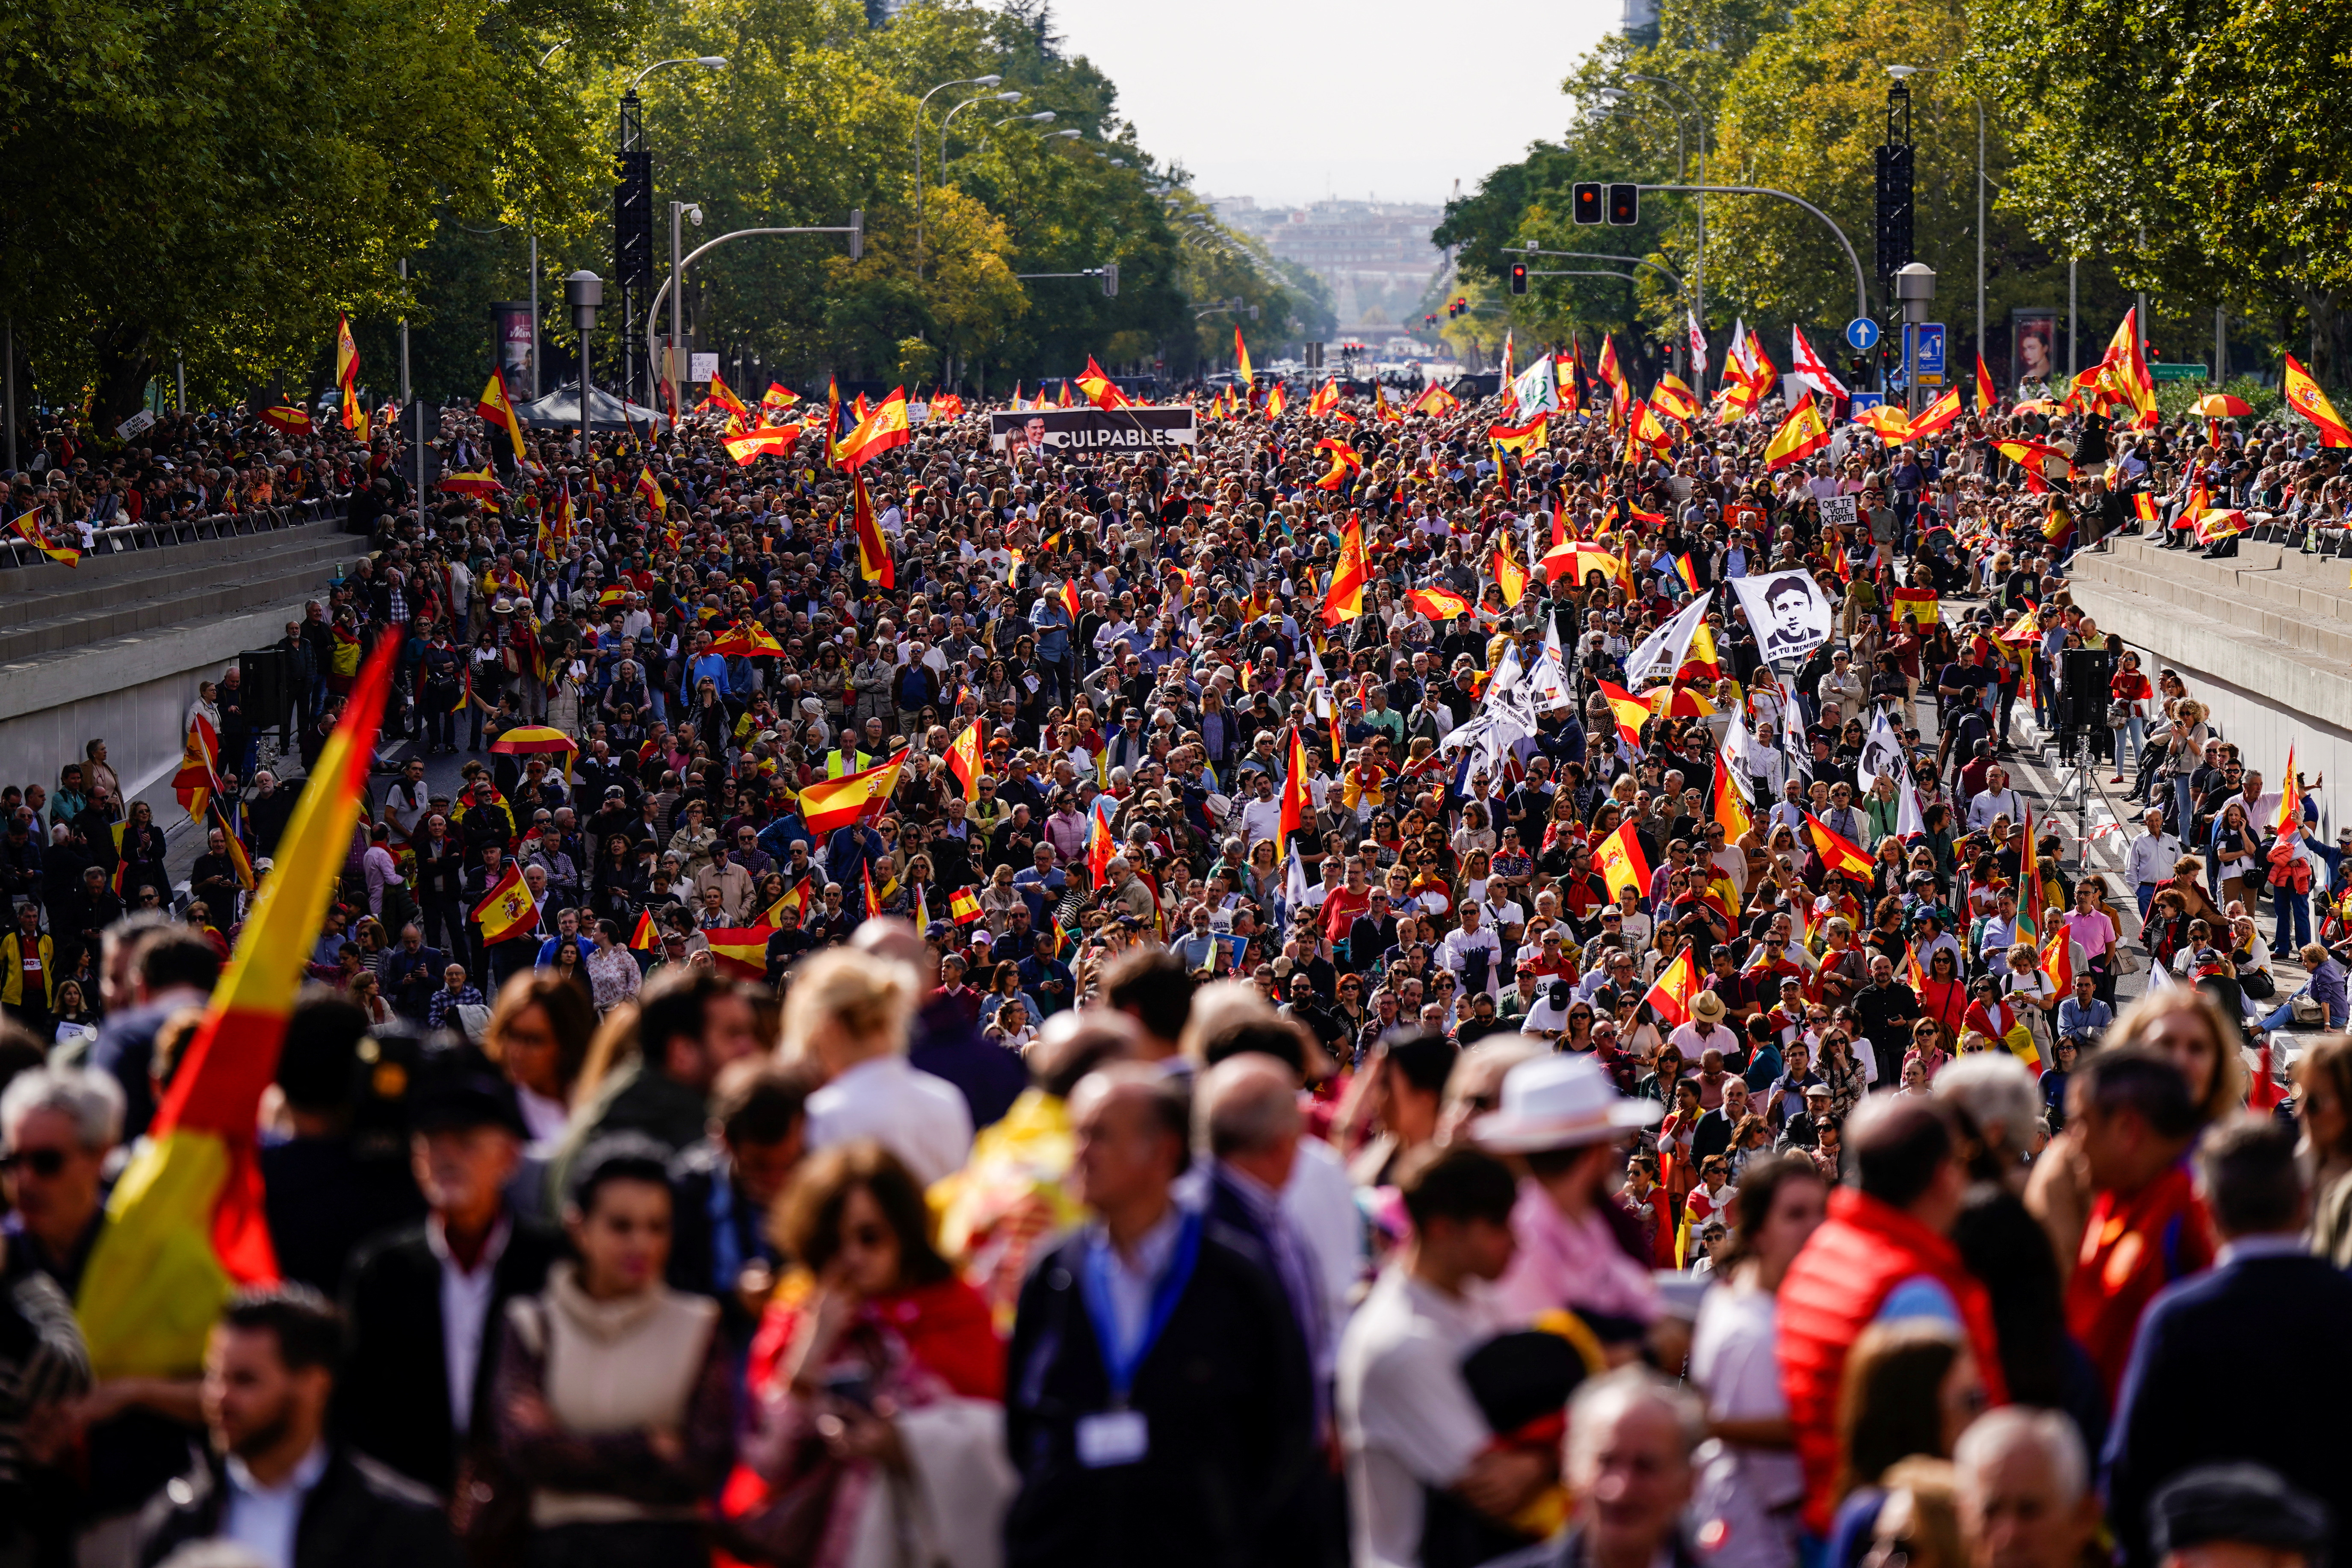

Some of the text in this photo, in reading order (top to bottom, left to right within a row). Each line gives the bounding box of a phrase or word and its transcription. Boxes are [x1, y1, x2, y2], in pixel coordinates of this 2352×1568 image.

[132, 415, 142, 424] DEJA
[132, 418, 145, 428] PACTAR
[1057, 429, 1177, 448] CULPABLES
[1823, 498, 1852, 510] QUE TE
[1830, 508, 1848, 516] VOTE
[1822, 513, 1855, 525] XTAPOTE
[1768, 638, 1825, 659] EN TU MEMORIA
[1492, 700, 1500, 708] EN
[1209, 921, 1230, 929] LORADO
